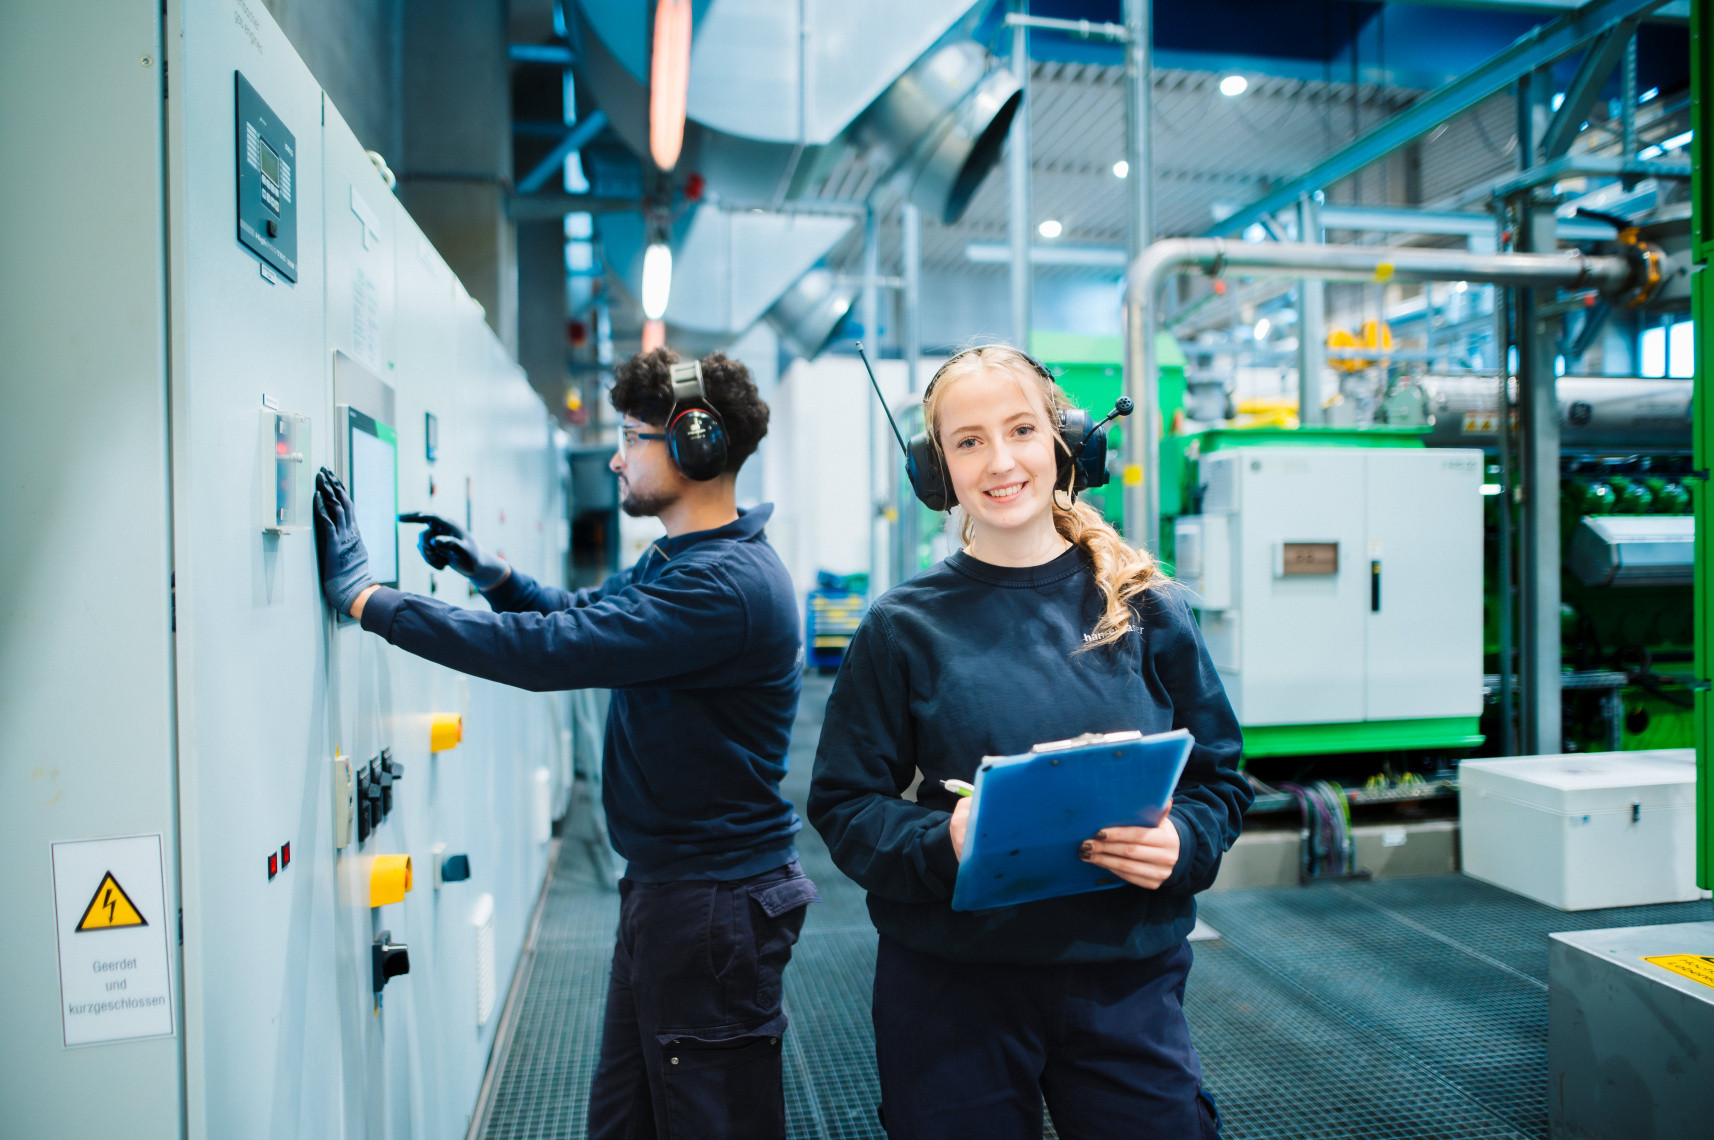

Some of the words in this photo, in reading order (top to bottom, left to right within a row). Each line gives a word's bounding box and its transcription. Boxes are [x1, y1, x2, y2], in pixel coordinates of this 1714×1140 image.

[92, 958, 138, 973] Geerdet
[105, 978, 127, 992] und
[68, 996, 166, 1016] kurzgeschlossen
